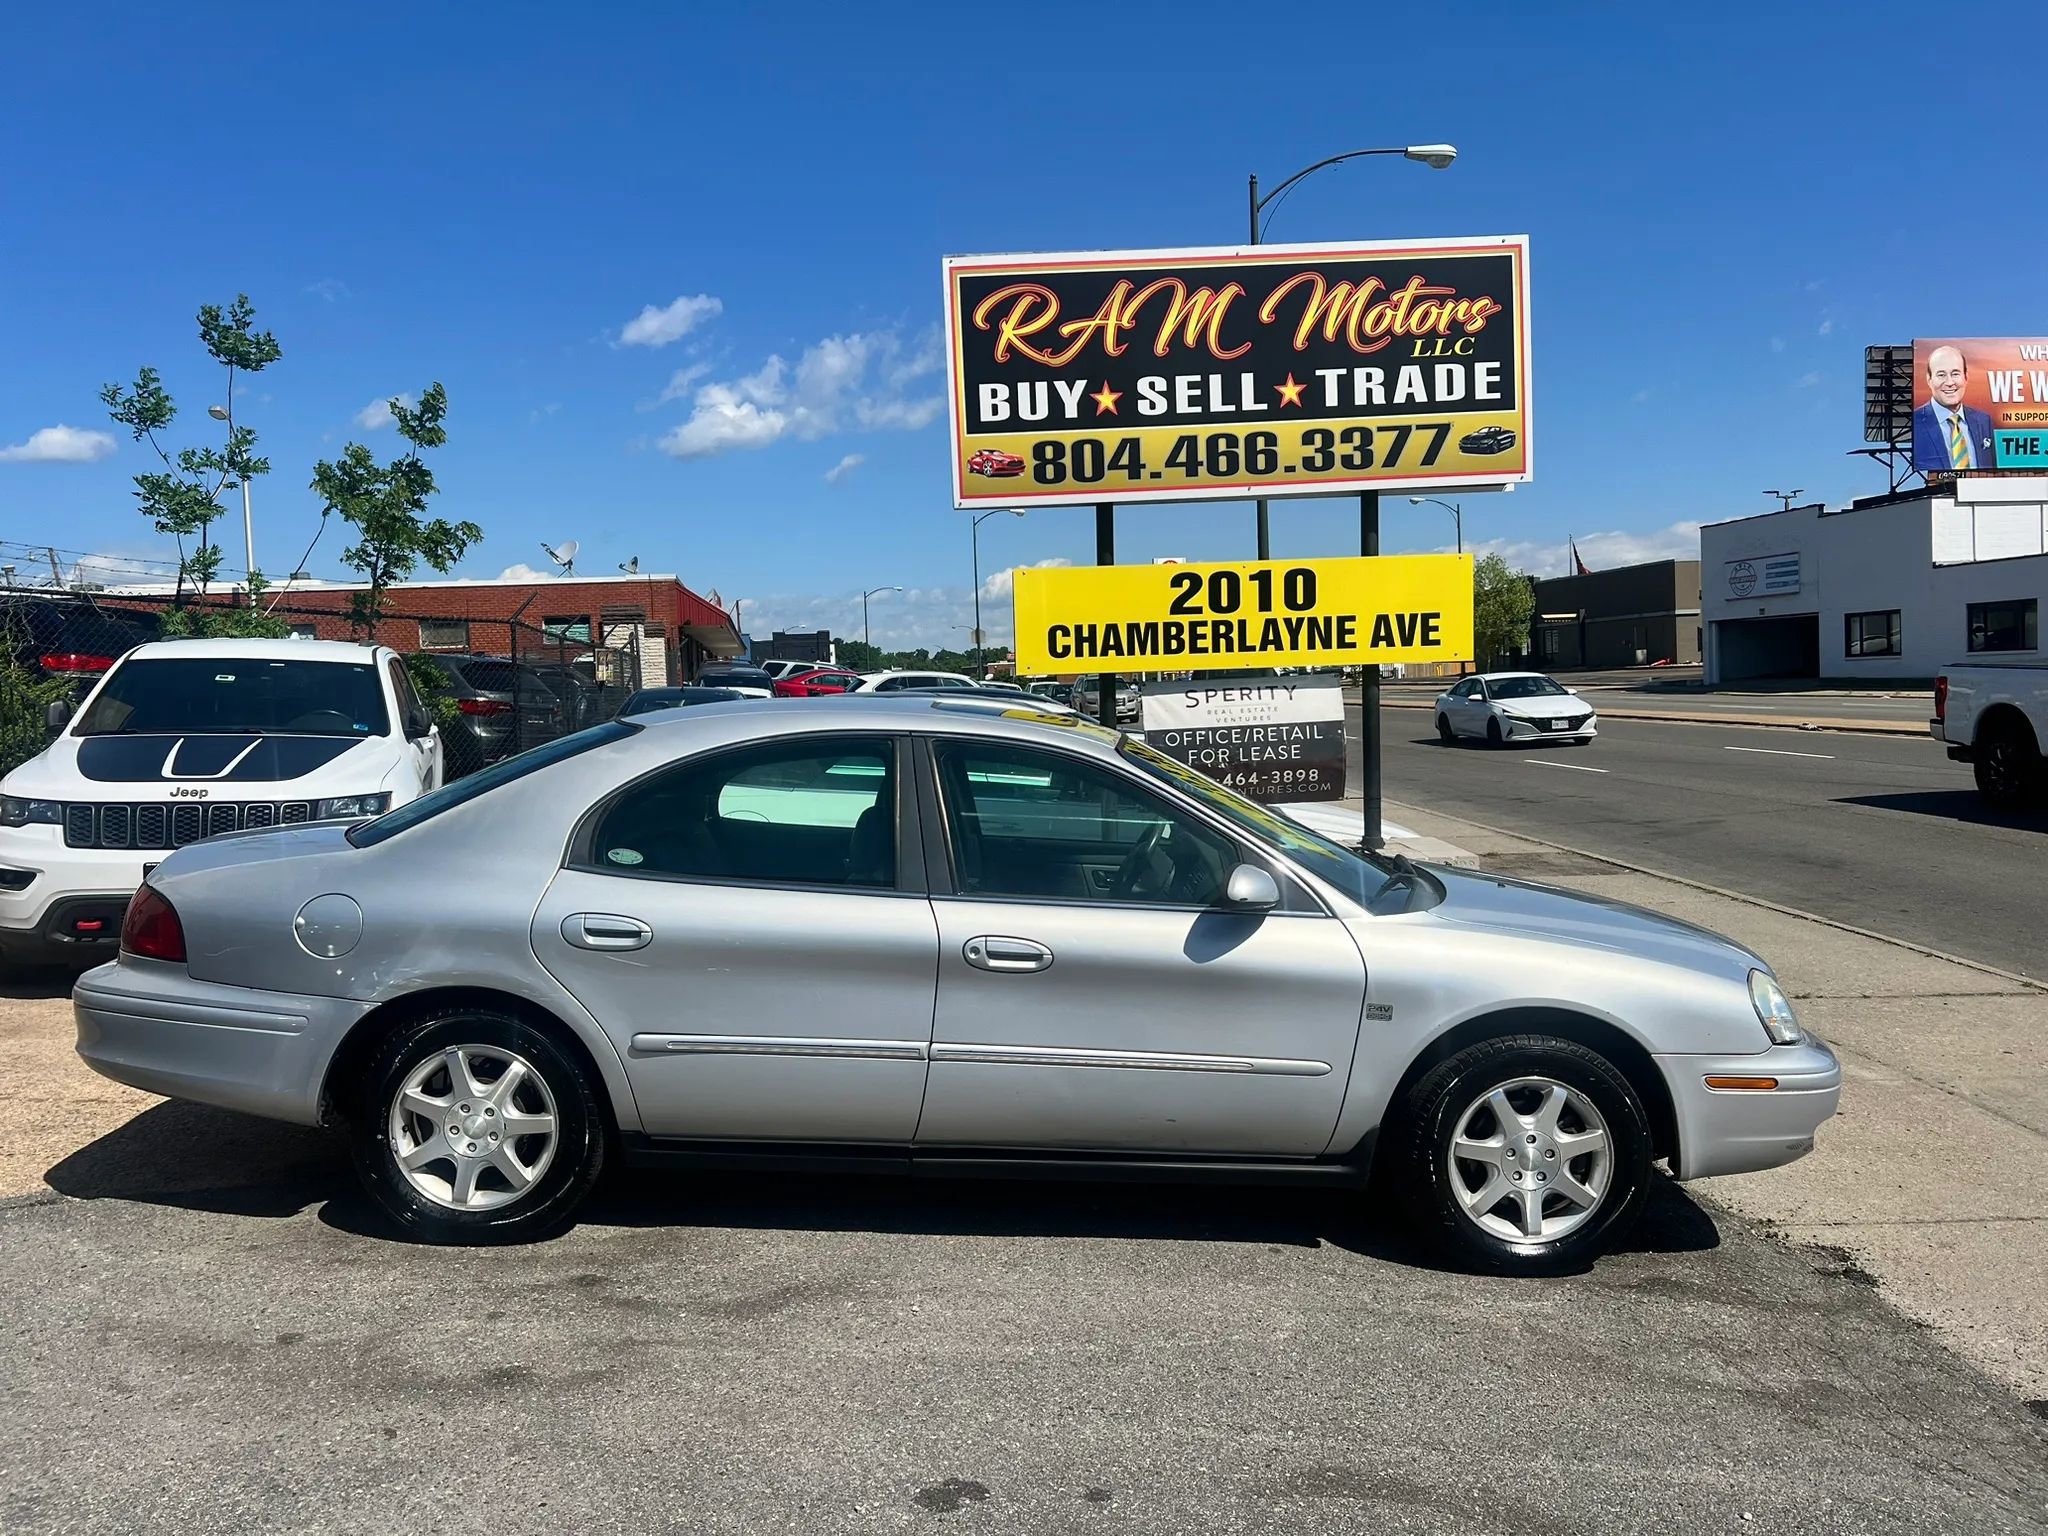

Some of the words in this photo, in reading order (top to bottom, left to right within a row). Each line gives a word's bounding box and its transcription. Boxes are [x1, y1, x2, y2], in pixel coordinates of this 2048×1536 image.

[973, 276, 1252, 367] RAM
[1259, 271, 1502, 353] Motors
[1410, 337, 1476, 358] LLC
[979, 379, 1088, 423] BUY
[1137, 372, 1268, 416] SELL
[1316, 360, 1502, 408] TRADE
[1987, 369, 2024, 403] WE
[2002, 412, 2012, 421] IN
[1032, 422, 1453, 485] 804.466.3377
[2001, 437, 2040, 456] THE
[1169, 567, 1317, 616] 2010
[1047, 615, 1358, 659] CHAMBERLAYNE
[1370, 612, 1442, 649] AVE
[1185, 684, 1297, 708] SPERITY
[1215, 715, 1272, 724] VENTURES
[1240, 706, 1279, 714] ESTATE
[1165, 725, 1324, 747] OFFICE/RETAIL
[1188, 748, 1230, 765] FOR
[1239, 744, 1302, 762] LEASE
[169, 786, 209, 799] Jeep
